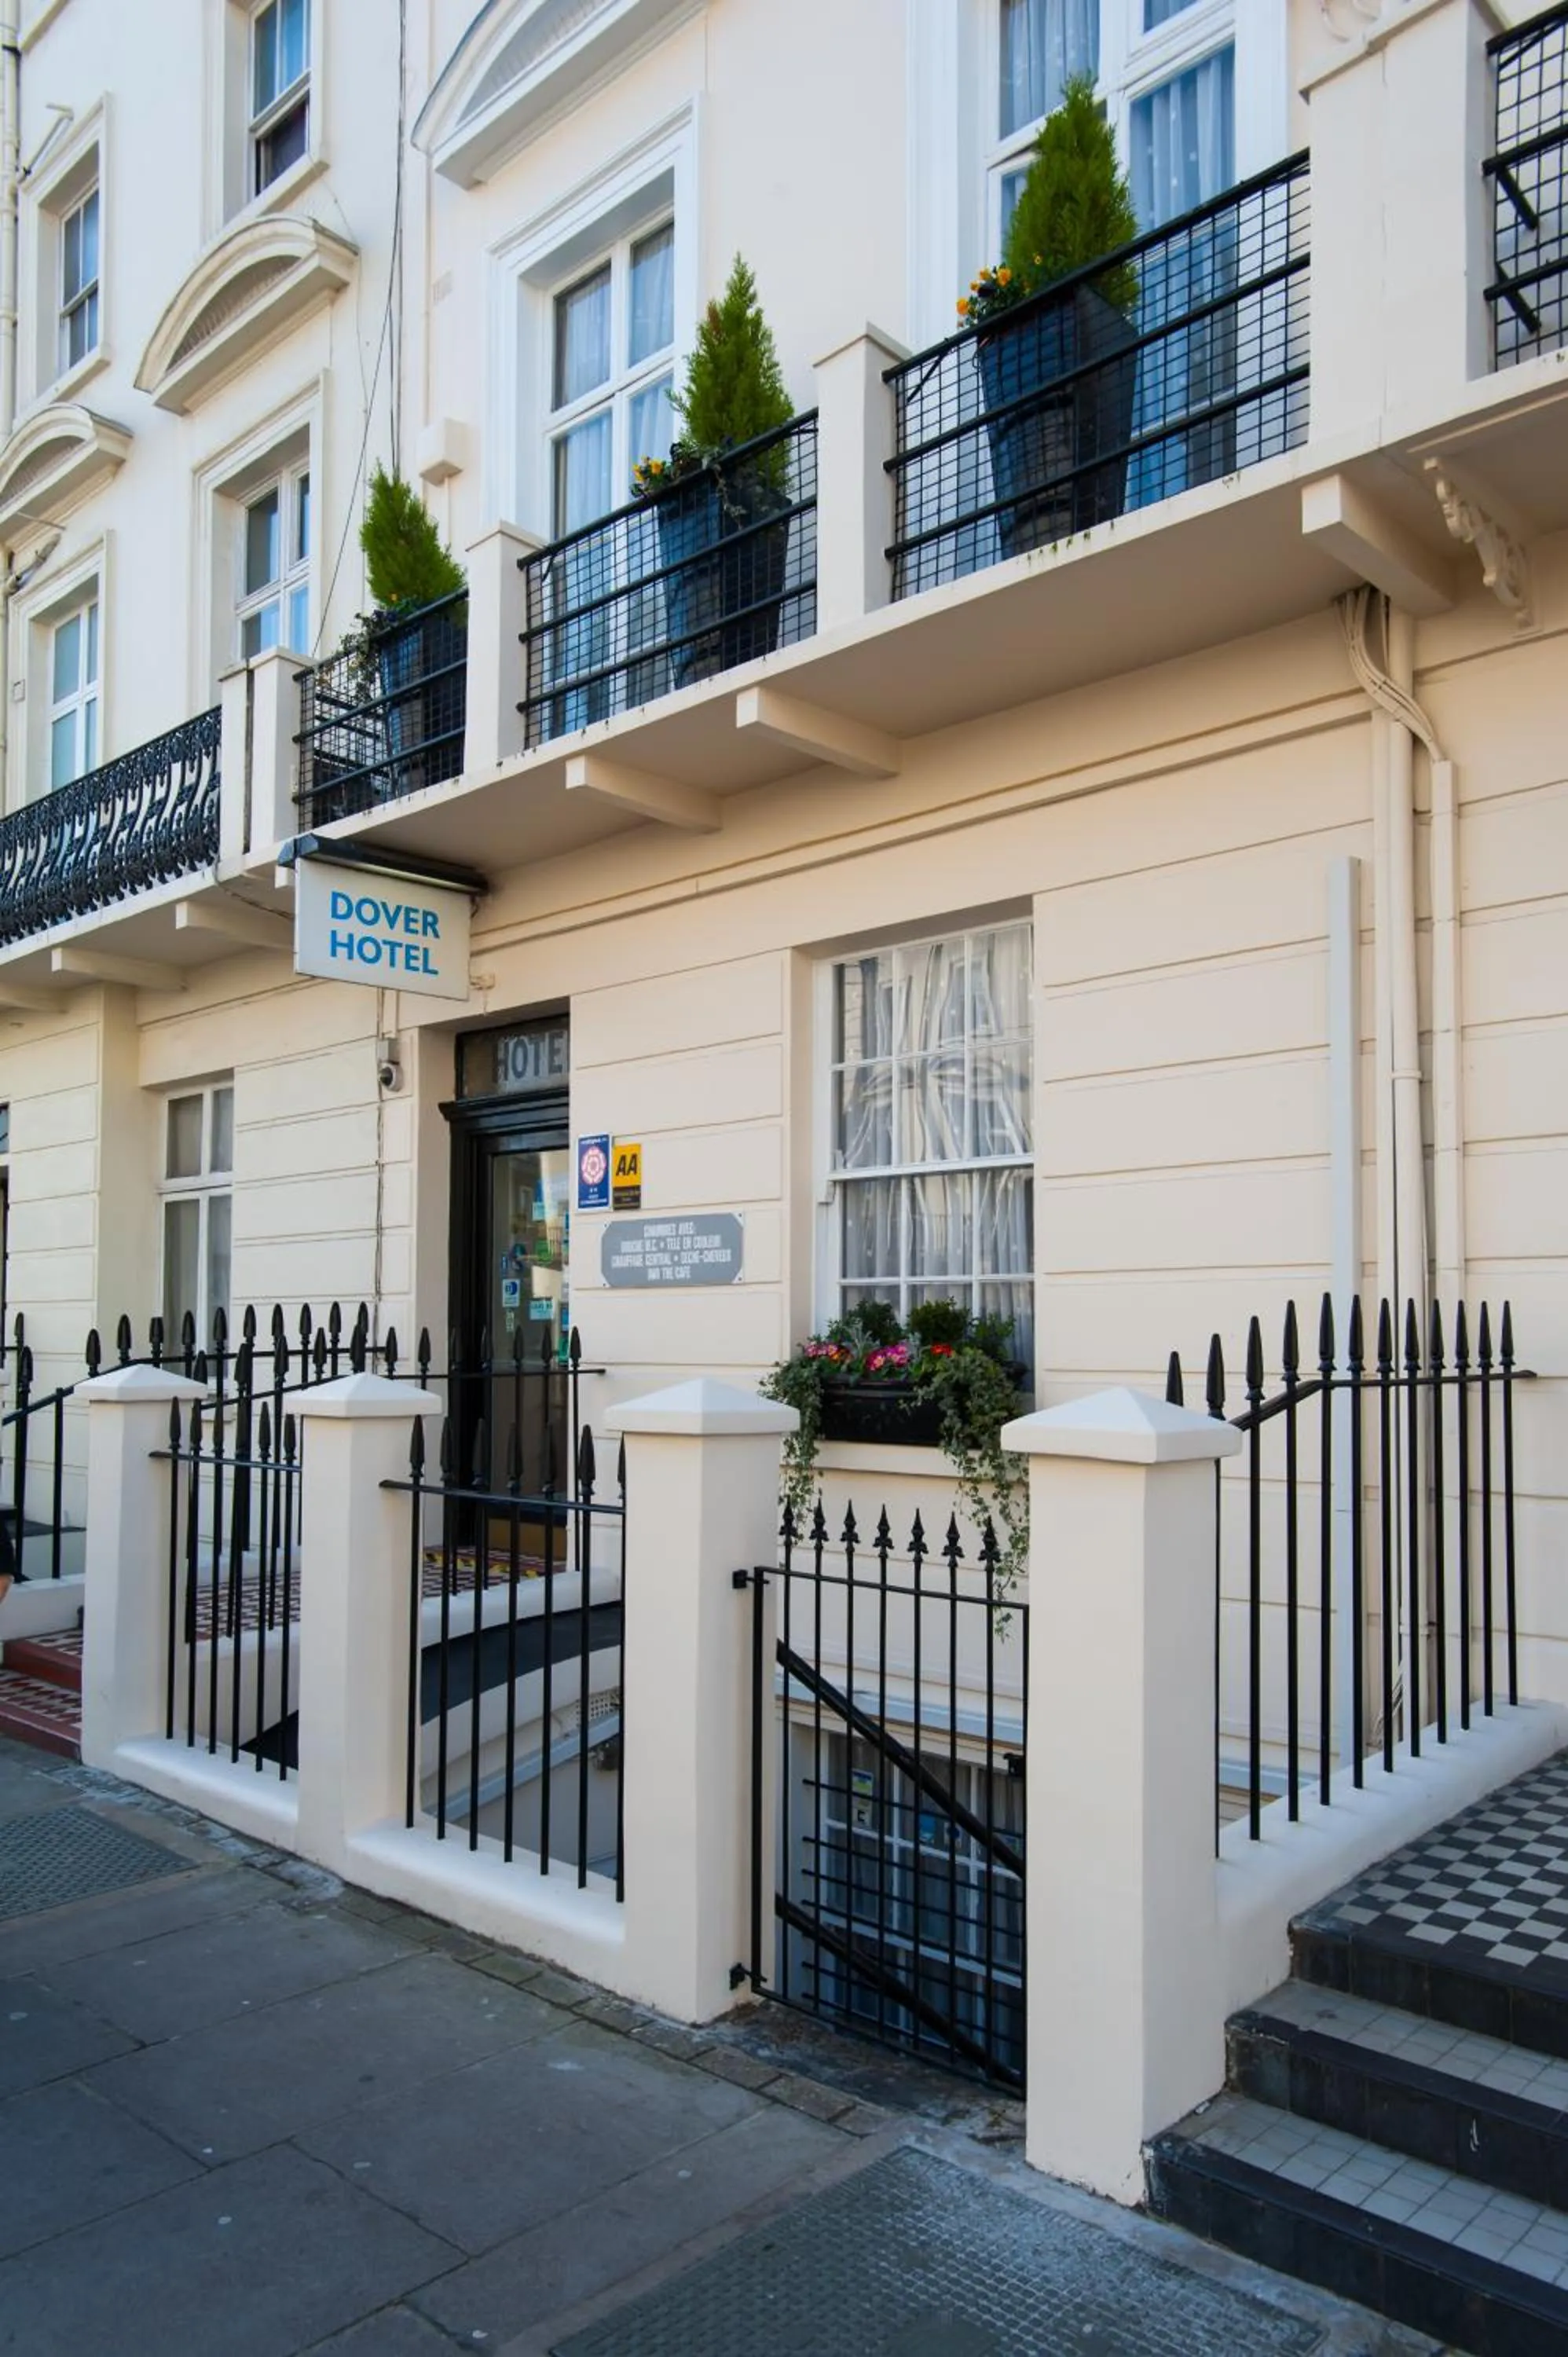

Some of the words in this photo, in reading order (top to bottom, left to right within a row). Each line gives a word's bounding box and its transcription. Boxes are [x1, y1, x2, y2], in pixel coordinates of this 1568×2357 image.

[331, 890, 440, 938] DOVER
[330, 929, 439, 975] HOTEL
[492, 1030, 570, 1083] HOTE
[616, 1153, 638, 1176] AA
